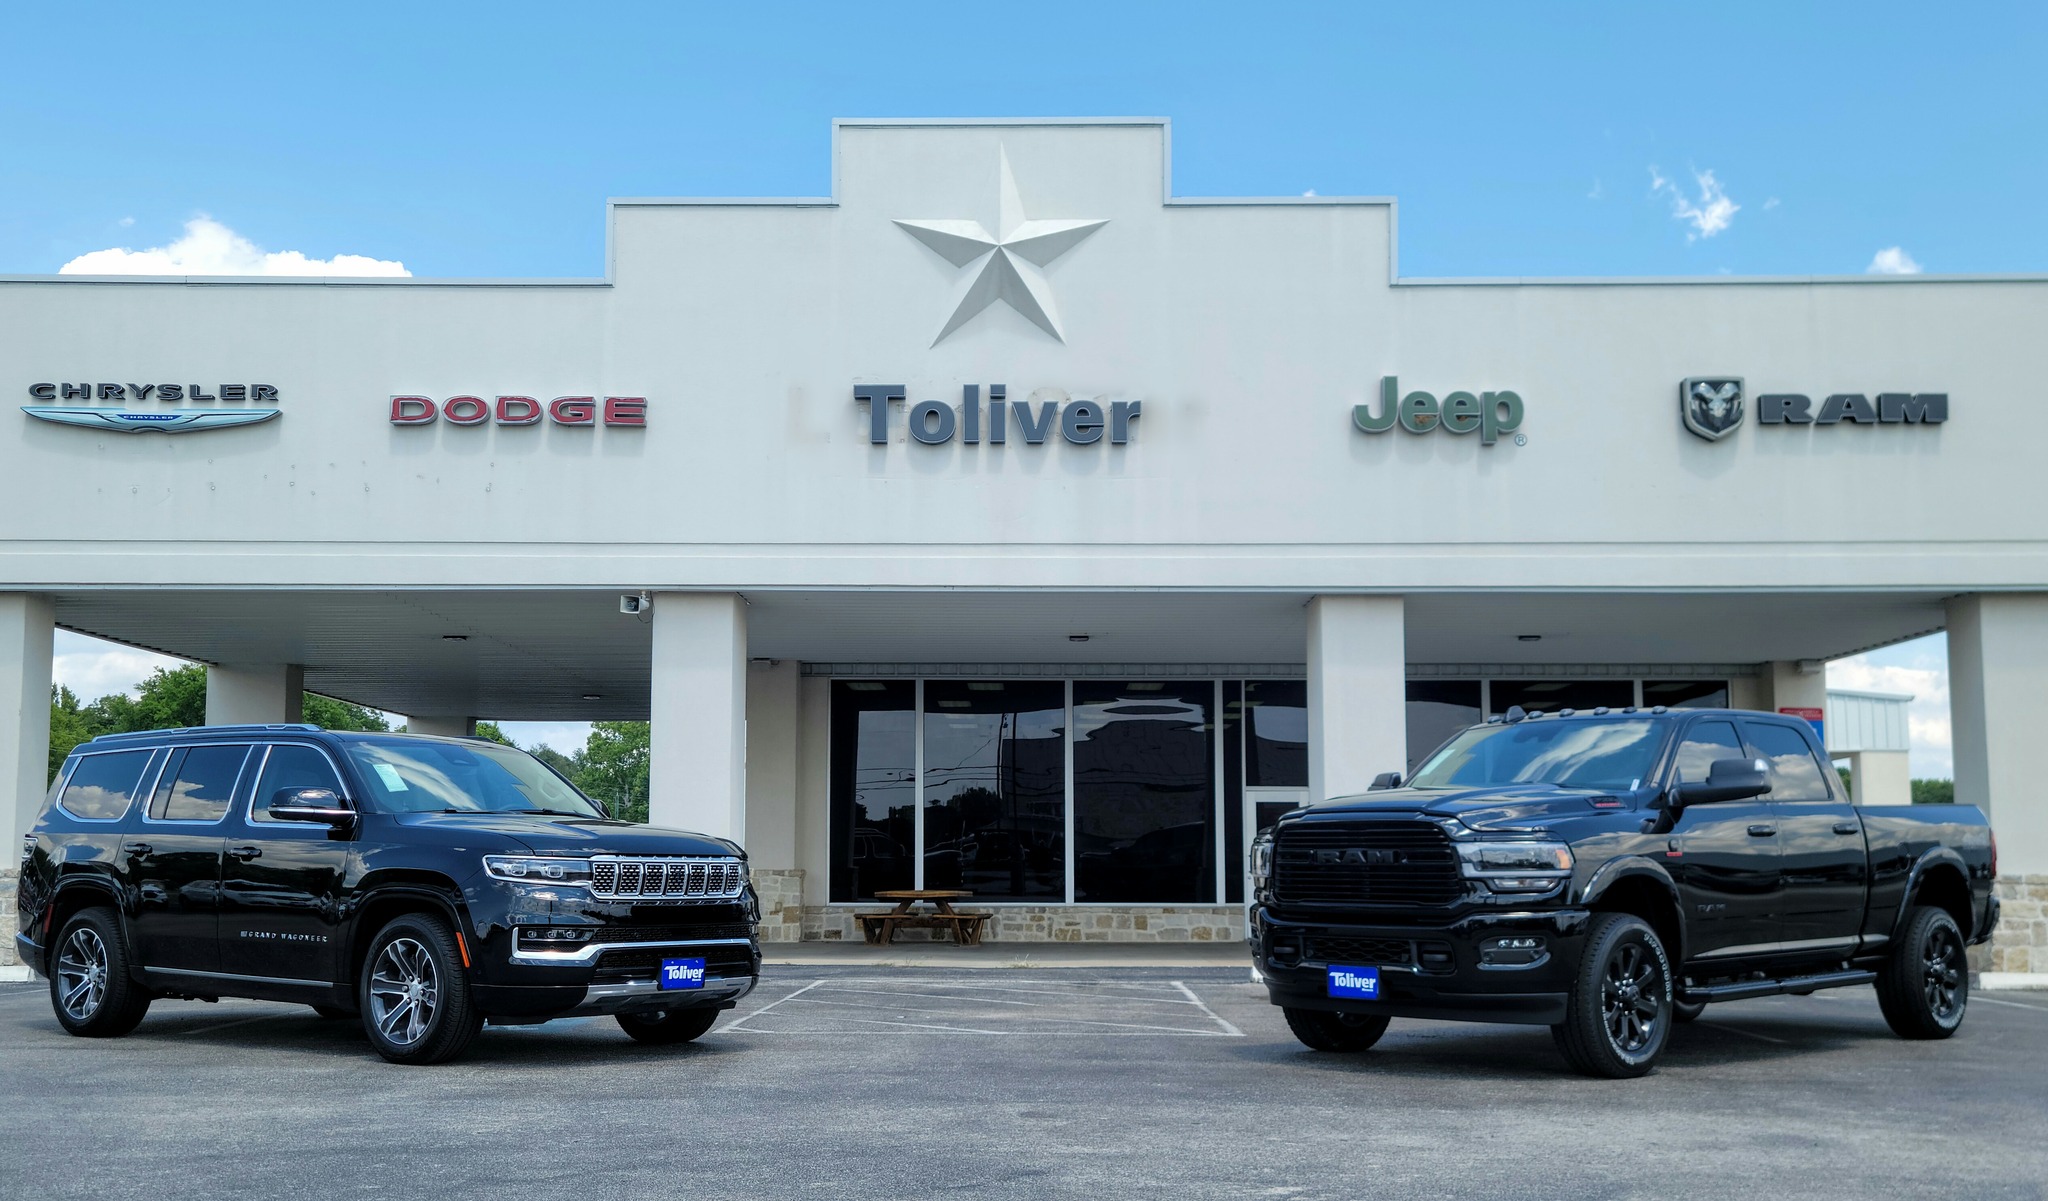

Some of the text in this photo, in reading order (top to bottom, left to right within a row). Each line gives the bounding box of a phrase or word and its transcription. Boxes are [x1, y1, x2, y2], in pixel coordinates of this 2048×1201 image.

[28, 382, 279, 402] CHRYSLER
[390, 395, 648, 427] DODGE
[853, 383, 1142, 446] Toliver
[1352, 375, 1525, 447] Jeep
[1757, 393, 1949, 424] RAM
[1316, 848, 1395, 865] RAM
[248, 931, 328, 943] GRAND WAGONEER
[664, 965, 704, 980] Toliver
[1329, 971, 1376, 989] Toliver
